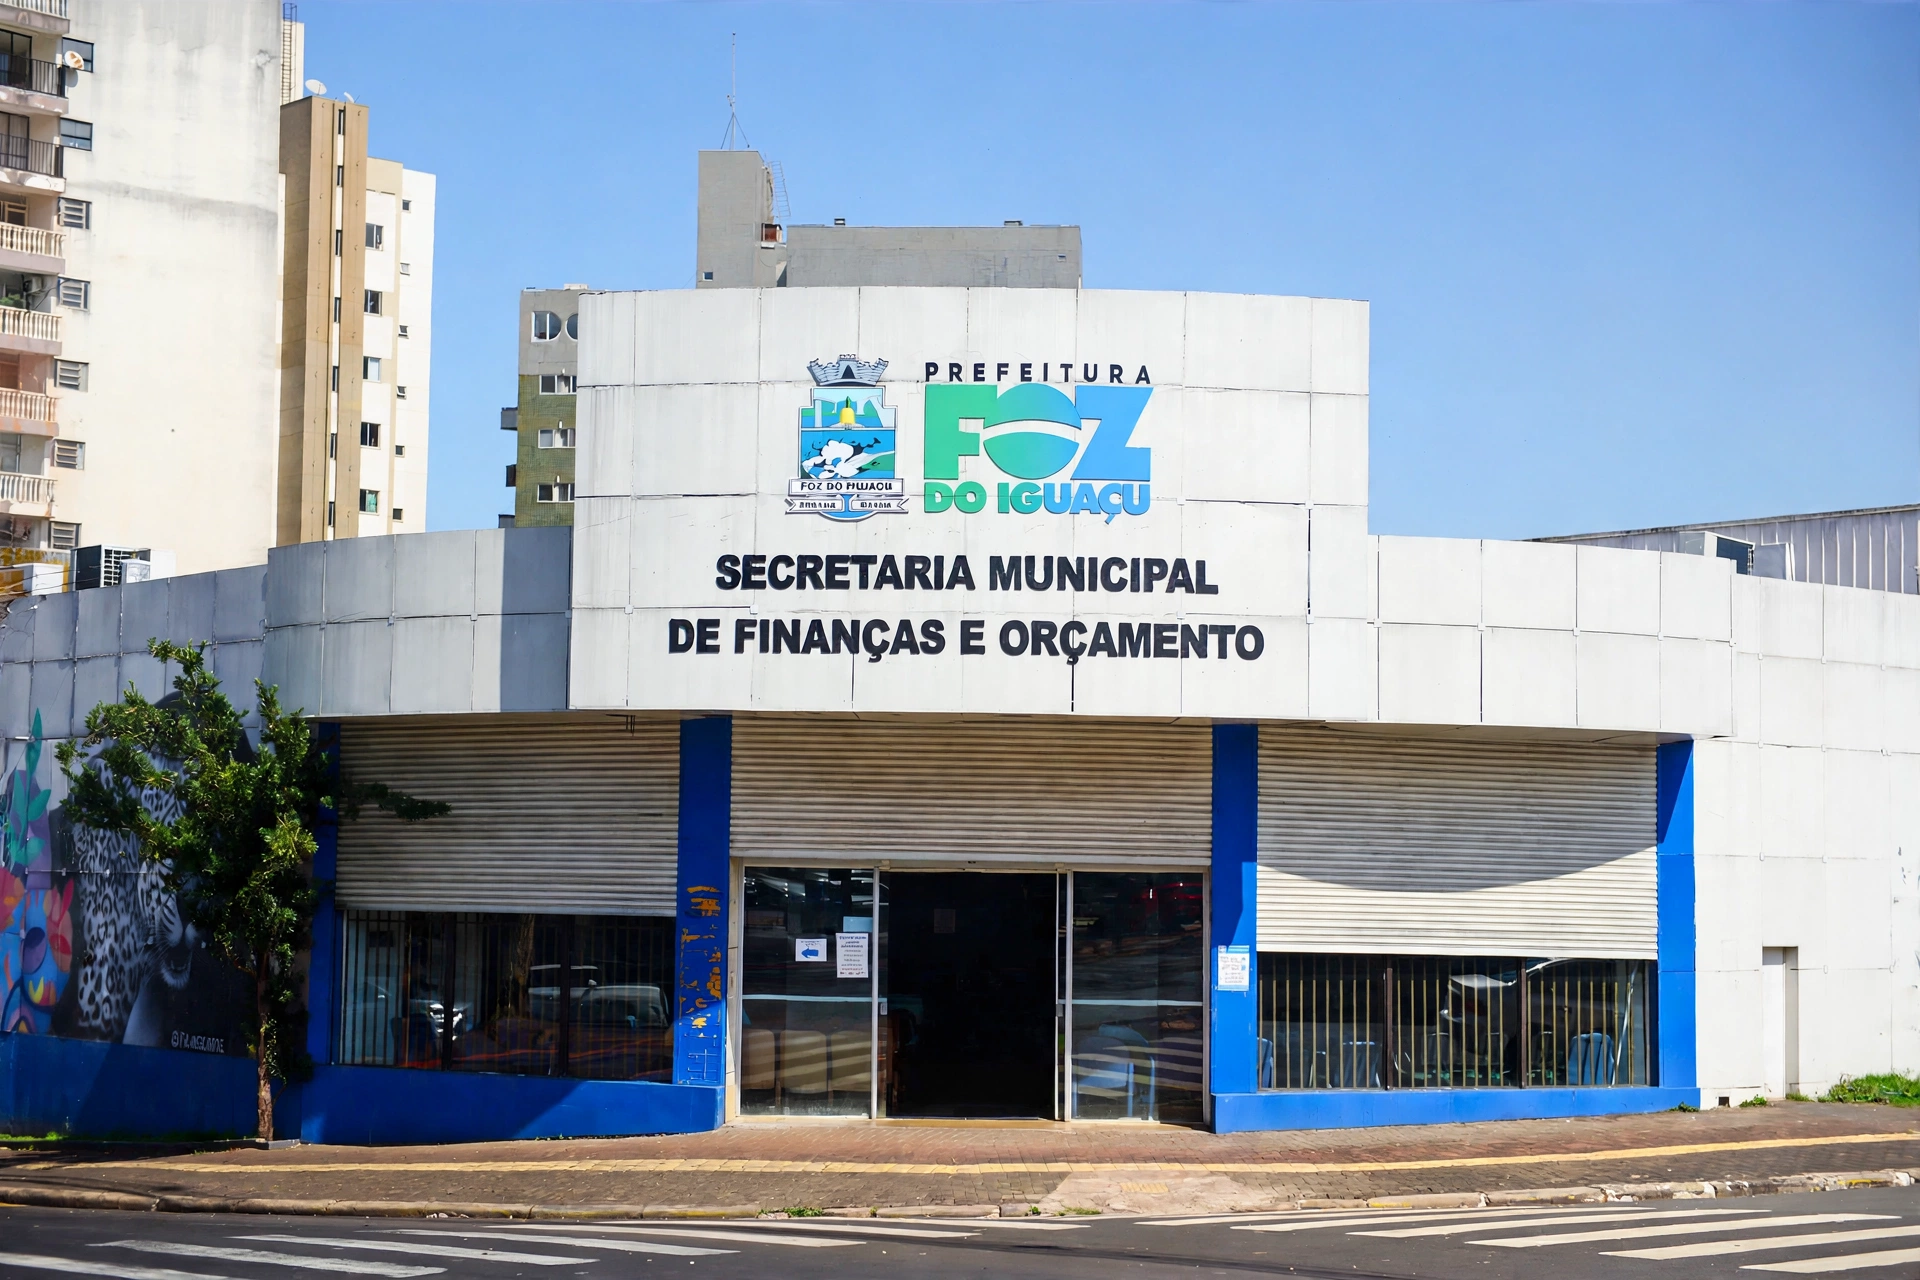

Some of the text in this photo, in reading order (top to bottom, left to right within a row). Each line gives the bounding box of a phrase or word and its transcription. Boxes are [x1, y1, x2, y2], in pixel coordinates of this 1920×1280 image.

[925, 361, 1152, 384] PREFEITURA
[923, 382, 1154, 482] FOZ
[923, 482, 1152, 524] DO IGUAÇU
[715, 553, 1219, 595] SECRETARIA MUNICIPAL
[668, 618, 1265, 665] DE FINANÇAS E ORÇAMENTO
